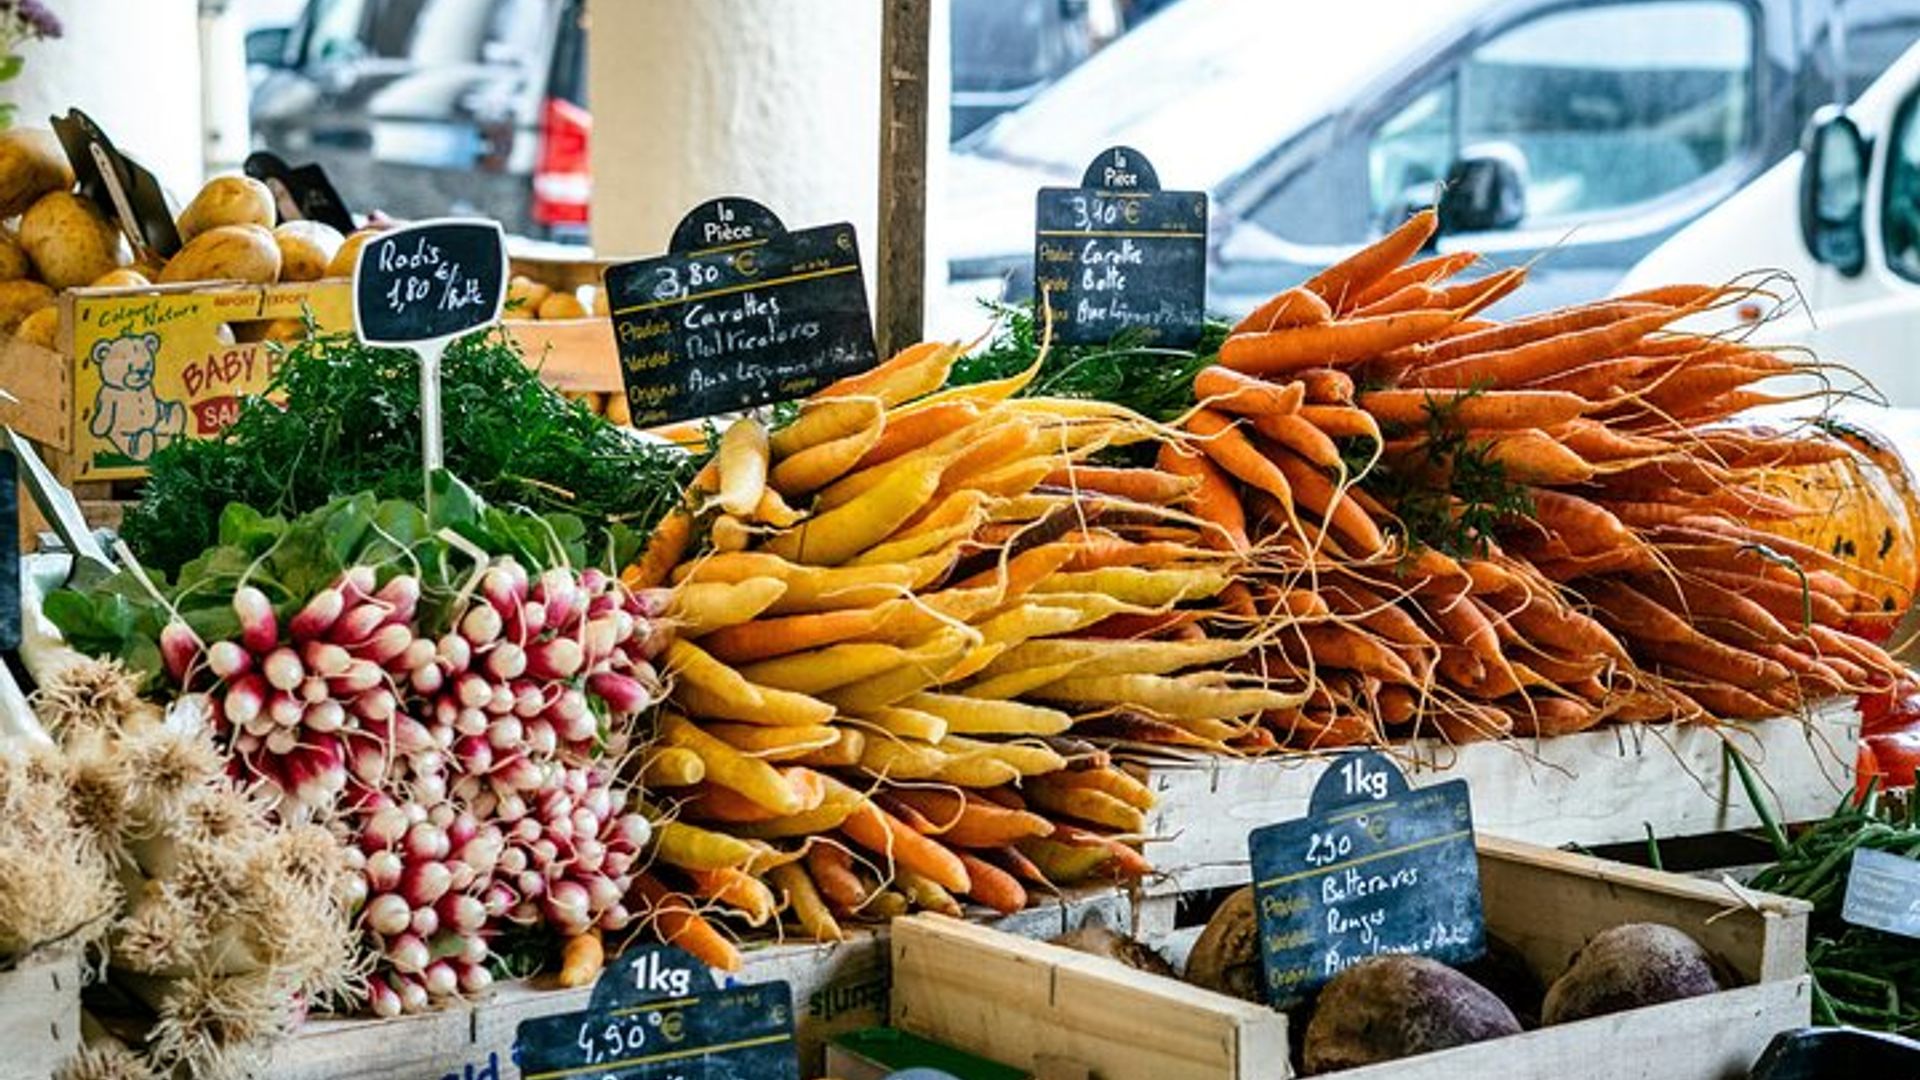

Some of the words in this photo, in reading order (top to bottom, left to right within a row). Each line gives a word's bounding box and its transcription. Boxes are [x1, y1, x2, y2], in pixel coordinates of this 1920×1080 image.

[717, 202, 735, 223] la
[704, 222, 752, 243] Pièce
[379, 236, 441, 272] Radis
[653, 262, 719, 300] 3,80
[684, 292, 780, 329] Carottes
[182, 347, 256, 397] BABY
[1341, 758, 1388, 799] 1kg
[631, 951, 691, 997] 1kg
[578, 1022, 644, 1064] 4,90
